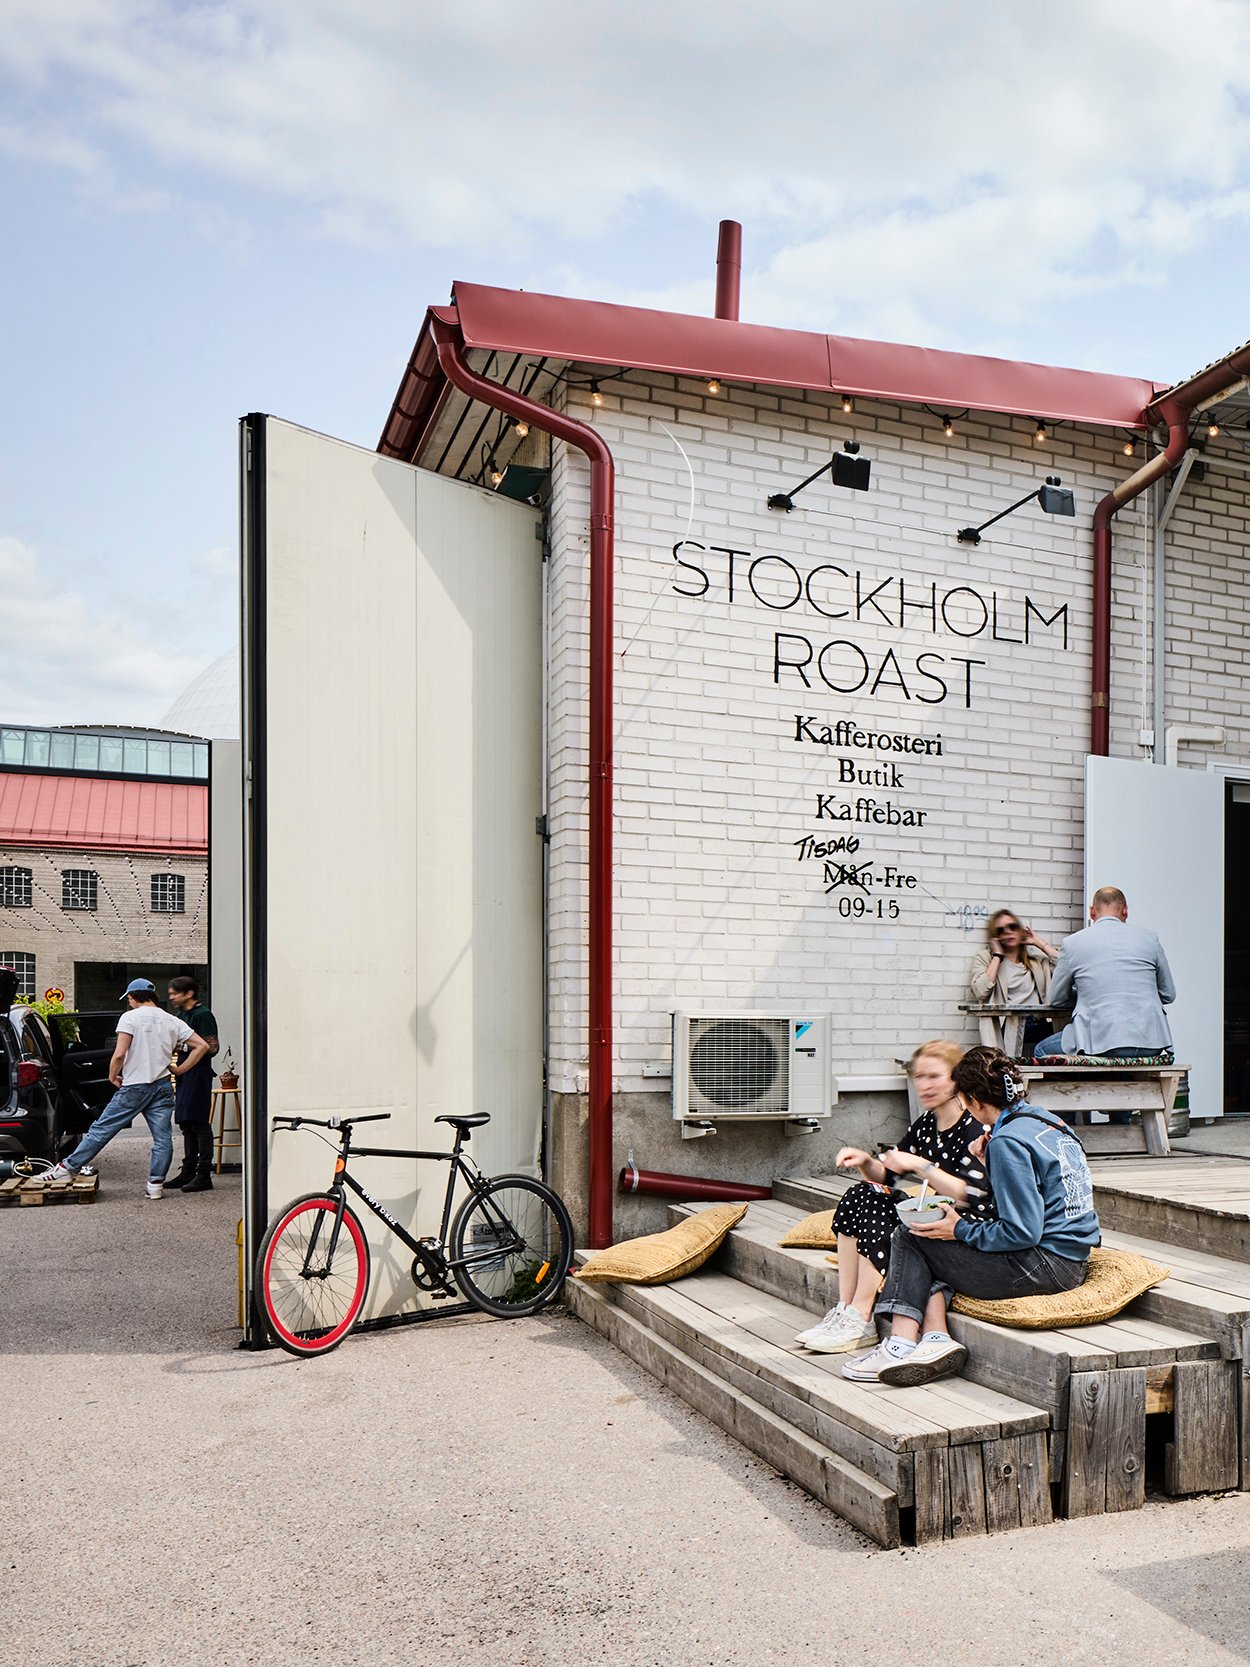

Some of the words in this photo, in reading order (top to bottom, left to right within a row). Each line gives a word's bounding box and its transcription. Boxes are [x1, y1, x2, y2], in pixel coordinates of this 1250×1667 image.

[672, 540, 1068, 651] STOCKHOLM
[774, 631, 986, 709] ROAST
[794, 714, 944, 756] Kafferosteri
[838, 758, 905, 788] Butik
[815, 794, 928, 827] Kaffebar
[838, 896, 901, 919] 09-15
